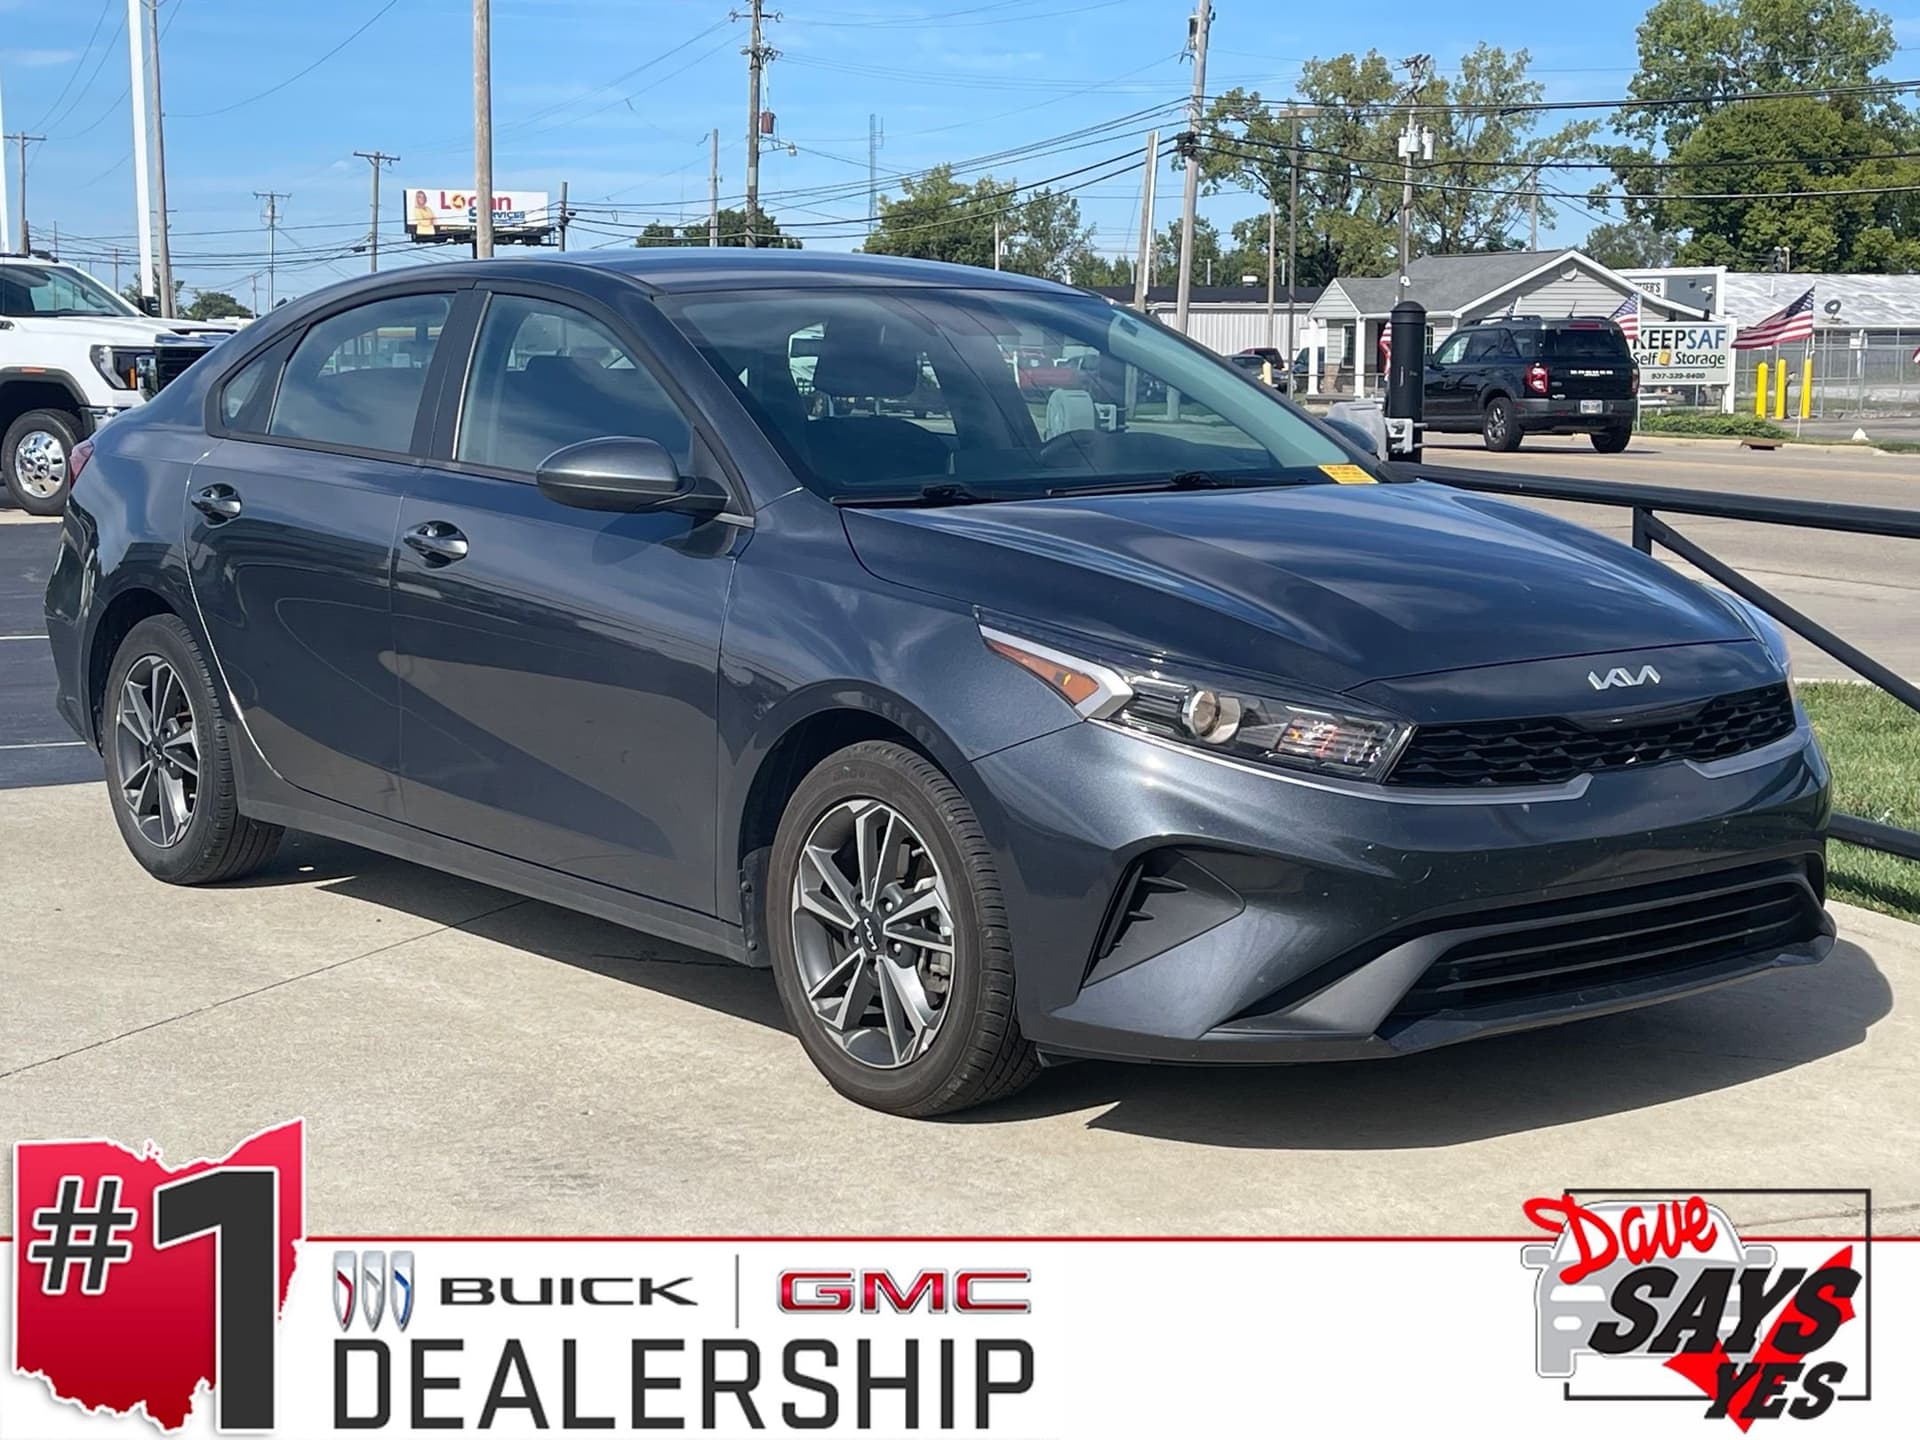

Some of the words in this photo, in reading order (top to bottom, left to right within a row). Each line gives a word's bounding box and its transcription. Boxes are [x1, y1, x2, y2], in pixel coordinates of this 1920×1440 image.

[1633, 352, 1658, 365] Self
[1675, 351, 1726, 368] Storage
[1588, 665, 1661, 690] KIA
